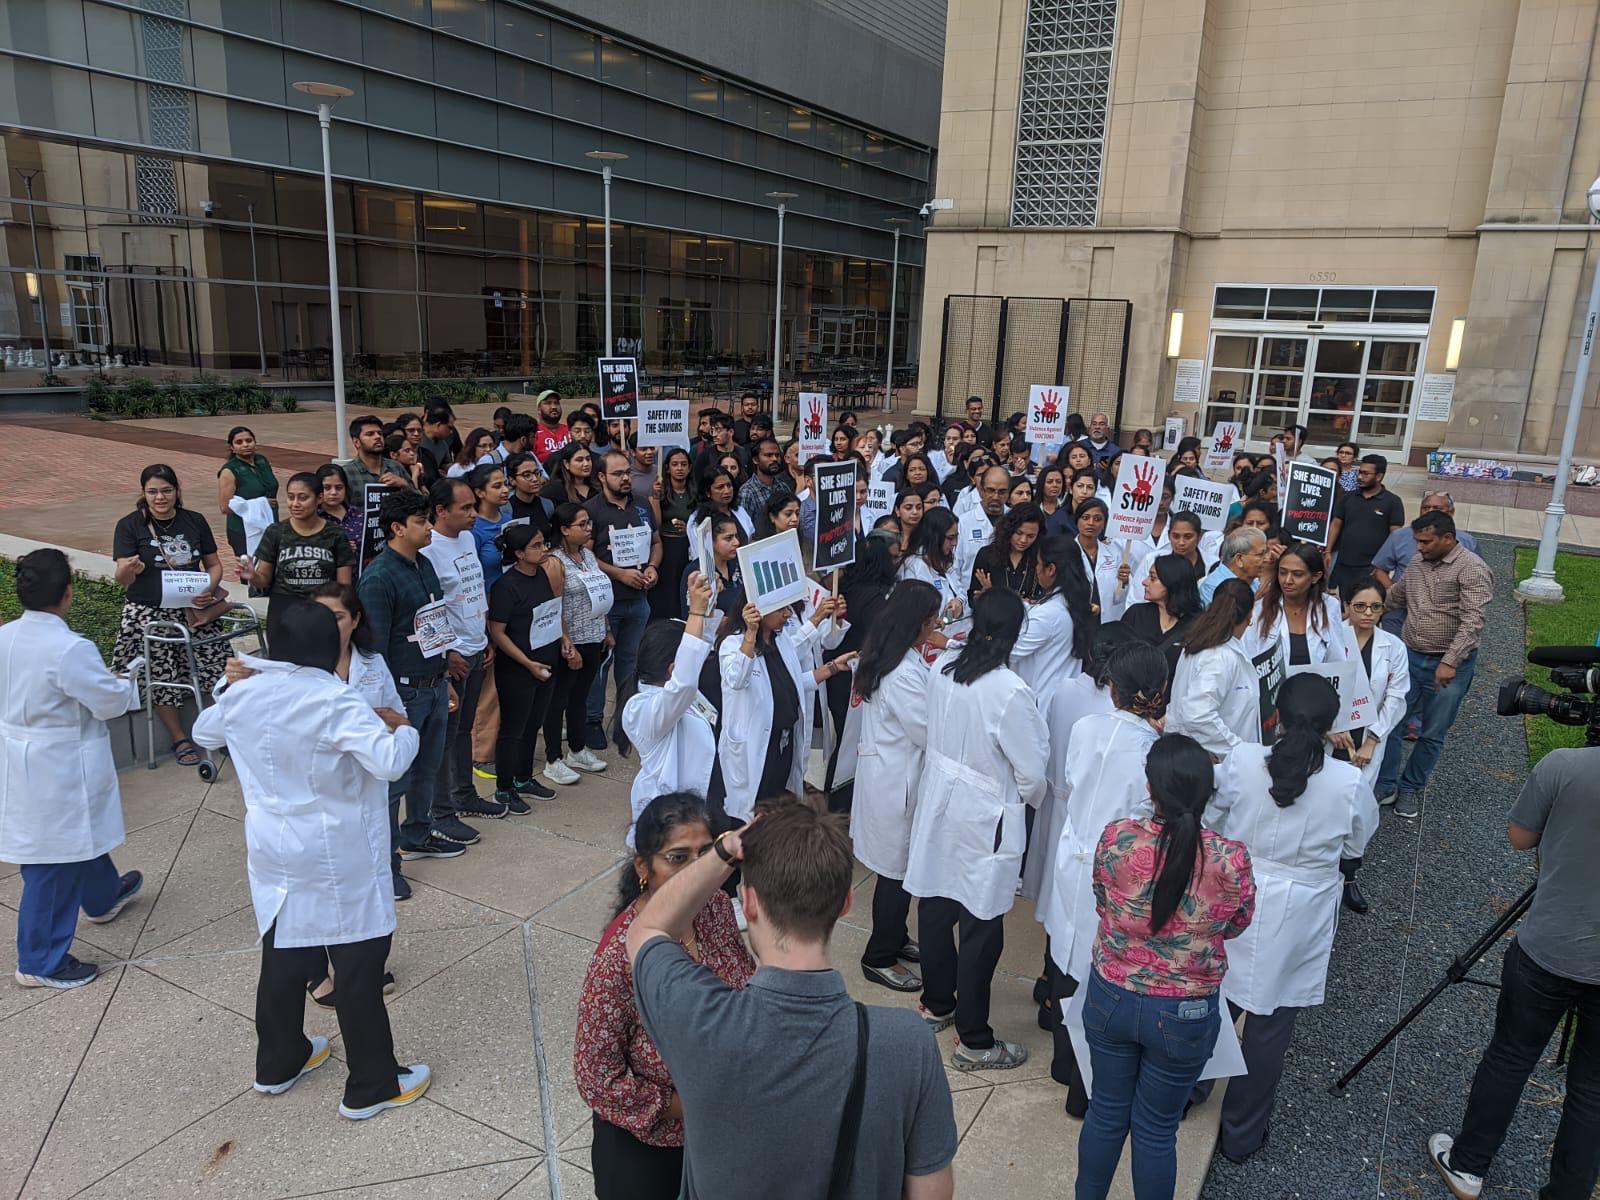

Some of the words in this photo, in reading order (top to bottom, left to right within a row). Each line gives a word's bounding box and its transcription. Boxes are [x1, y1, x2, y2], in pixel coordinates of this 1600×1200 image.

[1309, 271, 1337, 282] 6550
[602, 365, 614, 373] SHE
[615, 364, 633, 373] SAVED
[647, 409, 669, 421] SAFETY
[670, 409, 682, 420] FOR
[1033, 410, 1060, 424] STOP
[645, 423, 657, 434] THE
[658, 422, 683, 433] SAVIORS
[804, 425, 823, 440] STOP
[1213, 442, 1233, 453] STOP
[820, 475, 834, 490] SHE
[836, 472, 854, 487] SAVED
[1293, 470, 1308, 481] SHE
[1310, 473, 1332, 488] SAVED
[873, 489, 886, 499] FOR
[1183, 486, 1208, 502] SAFETY
[1210, 491, 1223, 505] FOR
[1300, 482, 1322, 498] LIVES.
[368, 492, 381, 502] SHE
[829, 490, 848, 506] LIVES.
[1121, 492, 1154, 512] STOP
[866, 499, 887, 510] AVIORS
[1178, 499, 1191, 511] THE
[1193, 502, 1222, 518] SAVIORS
[367, 516, 380, 527] SHE
[1112, 513, 1136, 523] Violence
[1136, 516, 1153, 526] Against
[1119, 525, 1144, 535] DOCTORS
[279, 546, 334, 562] CLASSIC
[1256, 659, 1271, 678] SHE
